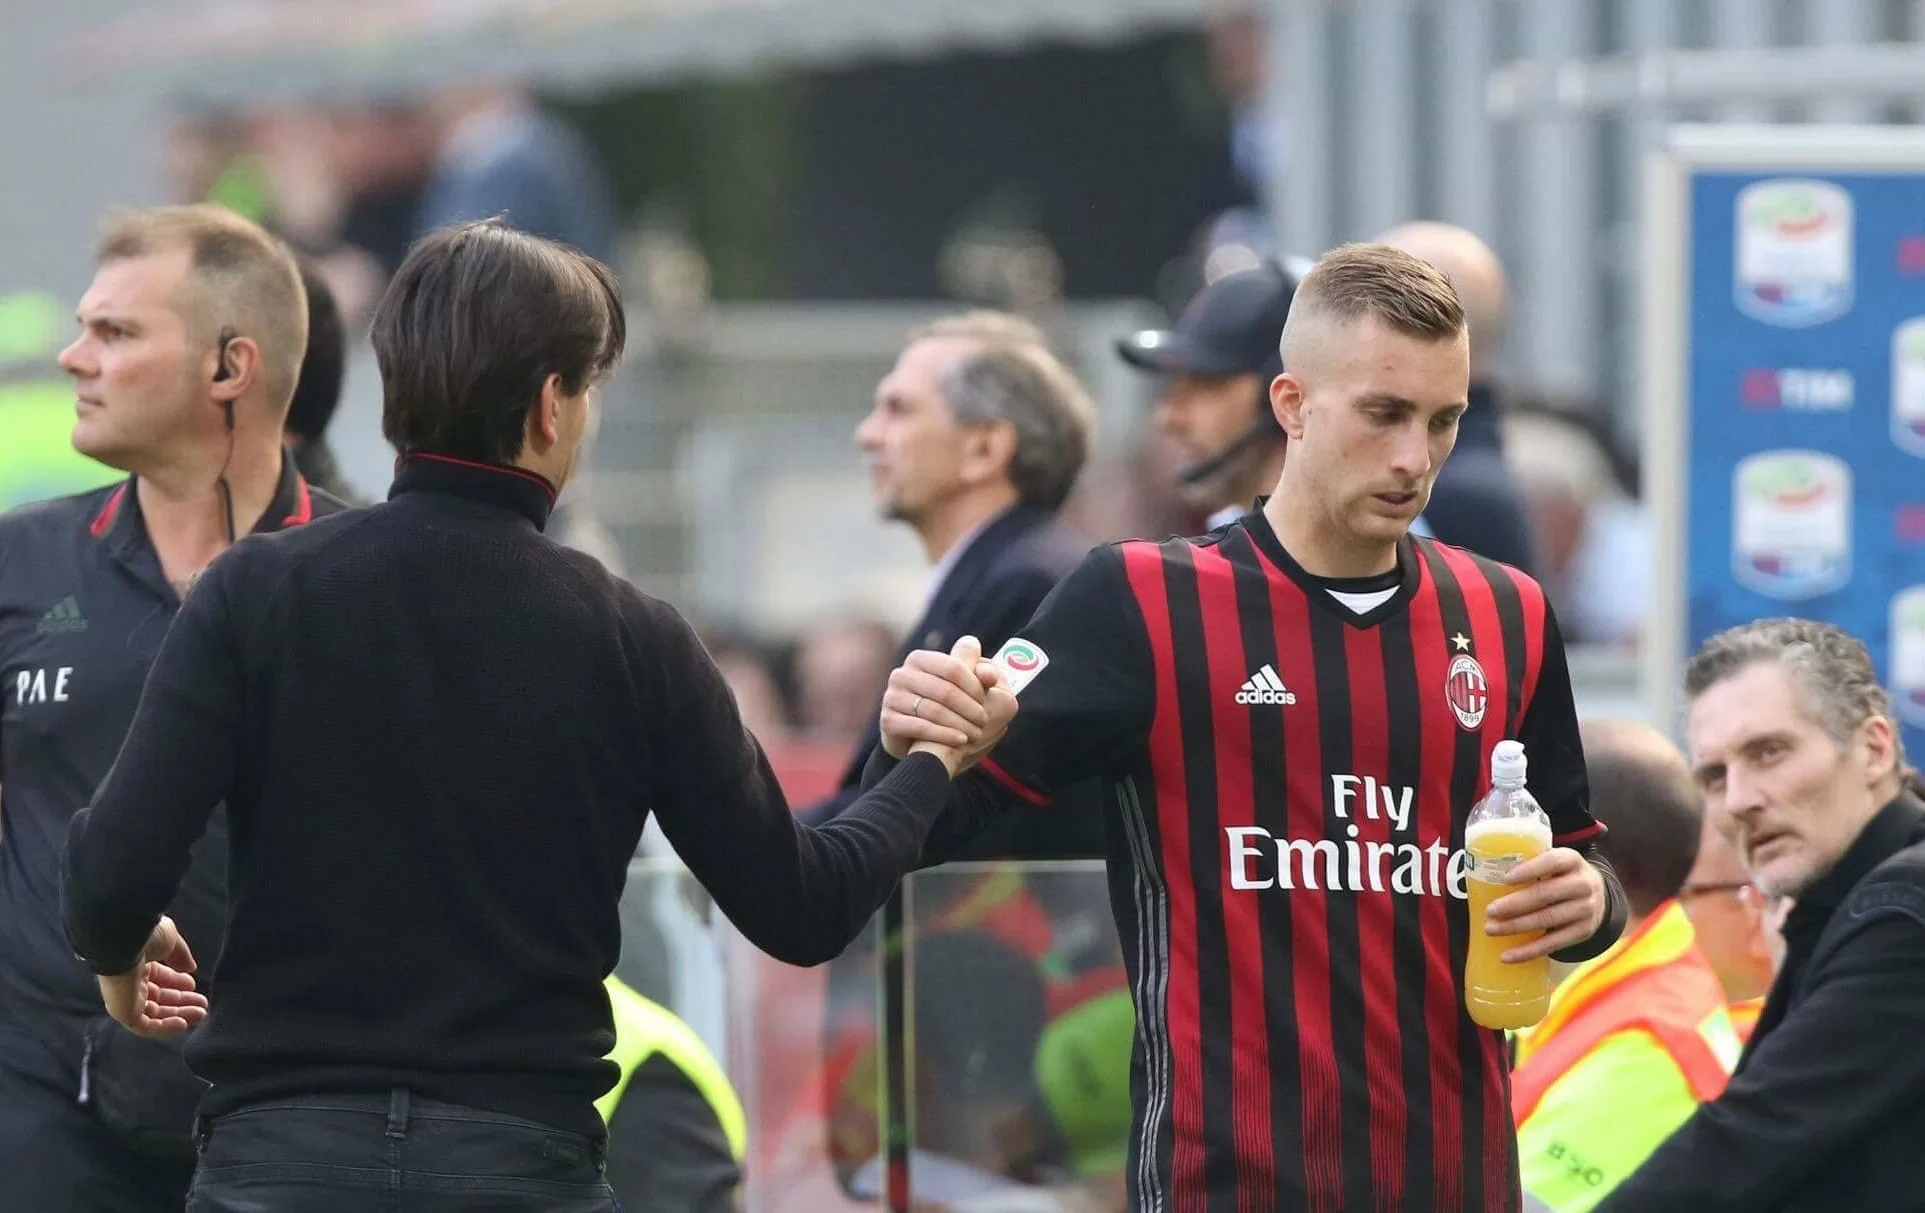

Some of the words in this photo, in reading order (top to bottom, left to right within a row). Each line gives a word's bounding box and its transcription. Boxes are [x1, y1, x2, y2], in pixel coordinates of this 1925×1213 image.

[1235, 688, 1296, 705] adidas
[1460, 712, 1480, 722] 1899
[1331, 774, 1414, 831] Fly
[1224, 824, 1469, 900] Emirate
